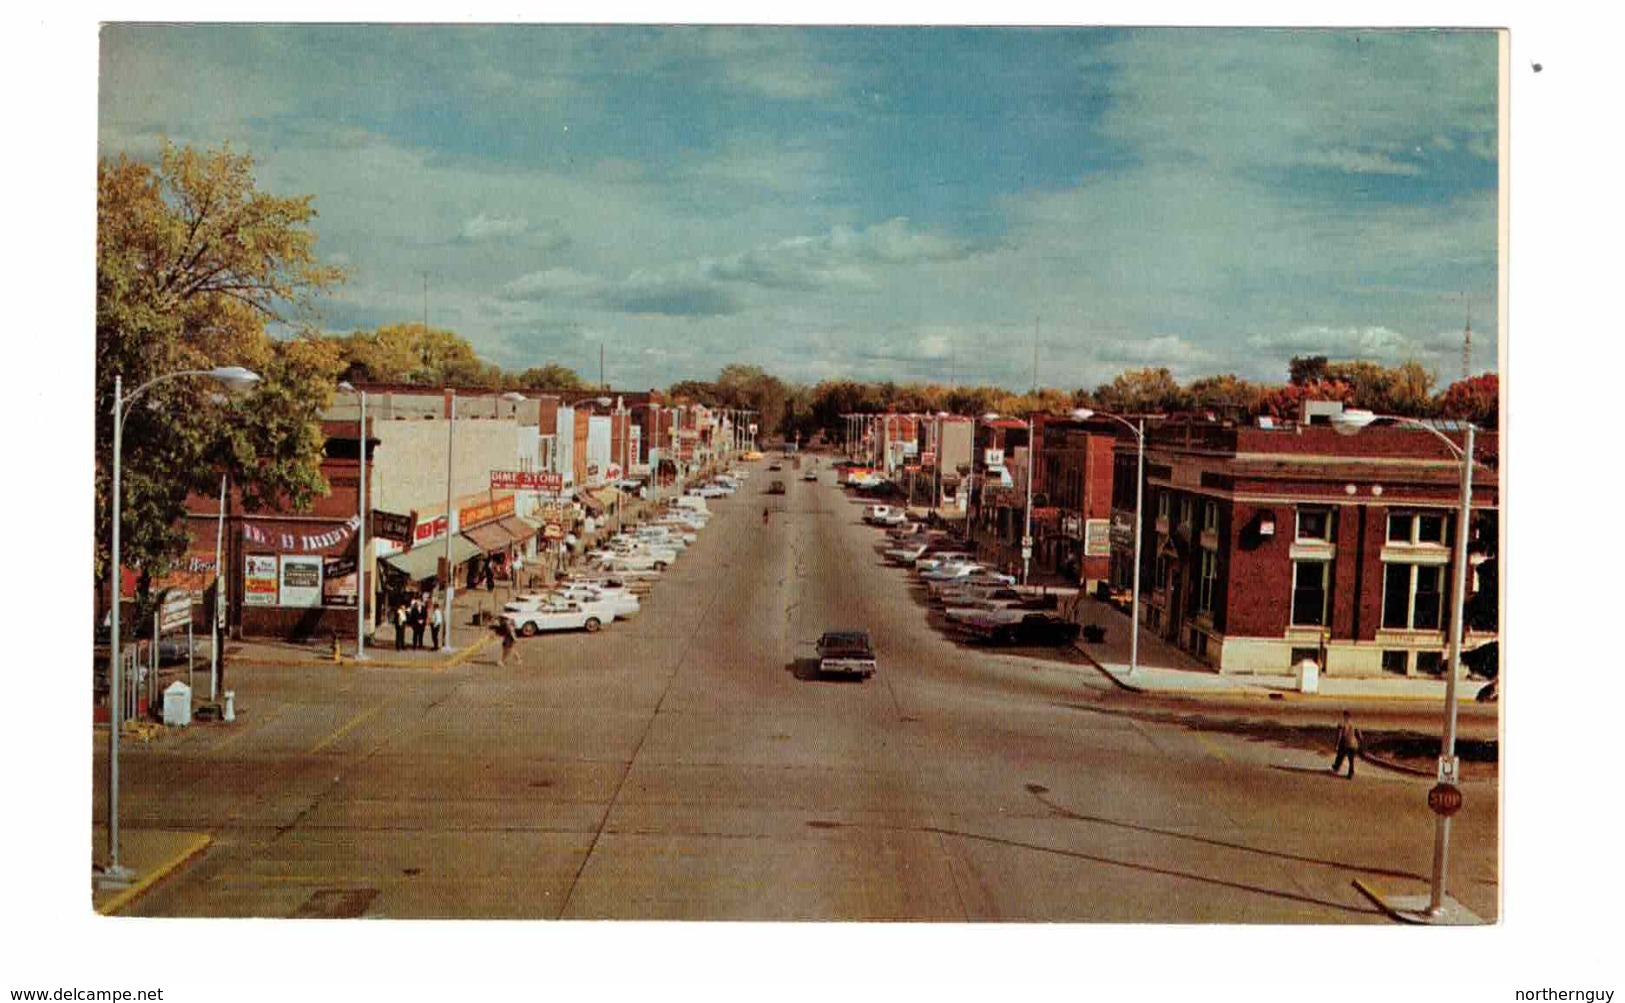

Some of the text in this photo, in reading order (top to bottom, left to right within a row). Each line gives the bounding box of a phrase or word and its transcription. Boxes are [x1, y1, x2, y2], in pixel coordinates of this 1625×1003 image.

[491, 471, 561, 483] DIME STORE
[1430, 792, 1460, 807] STOP
